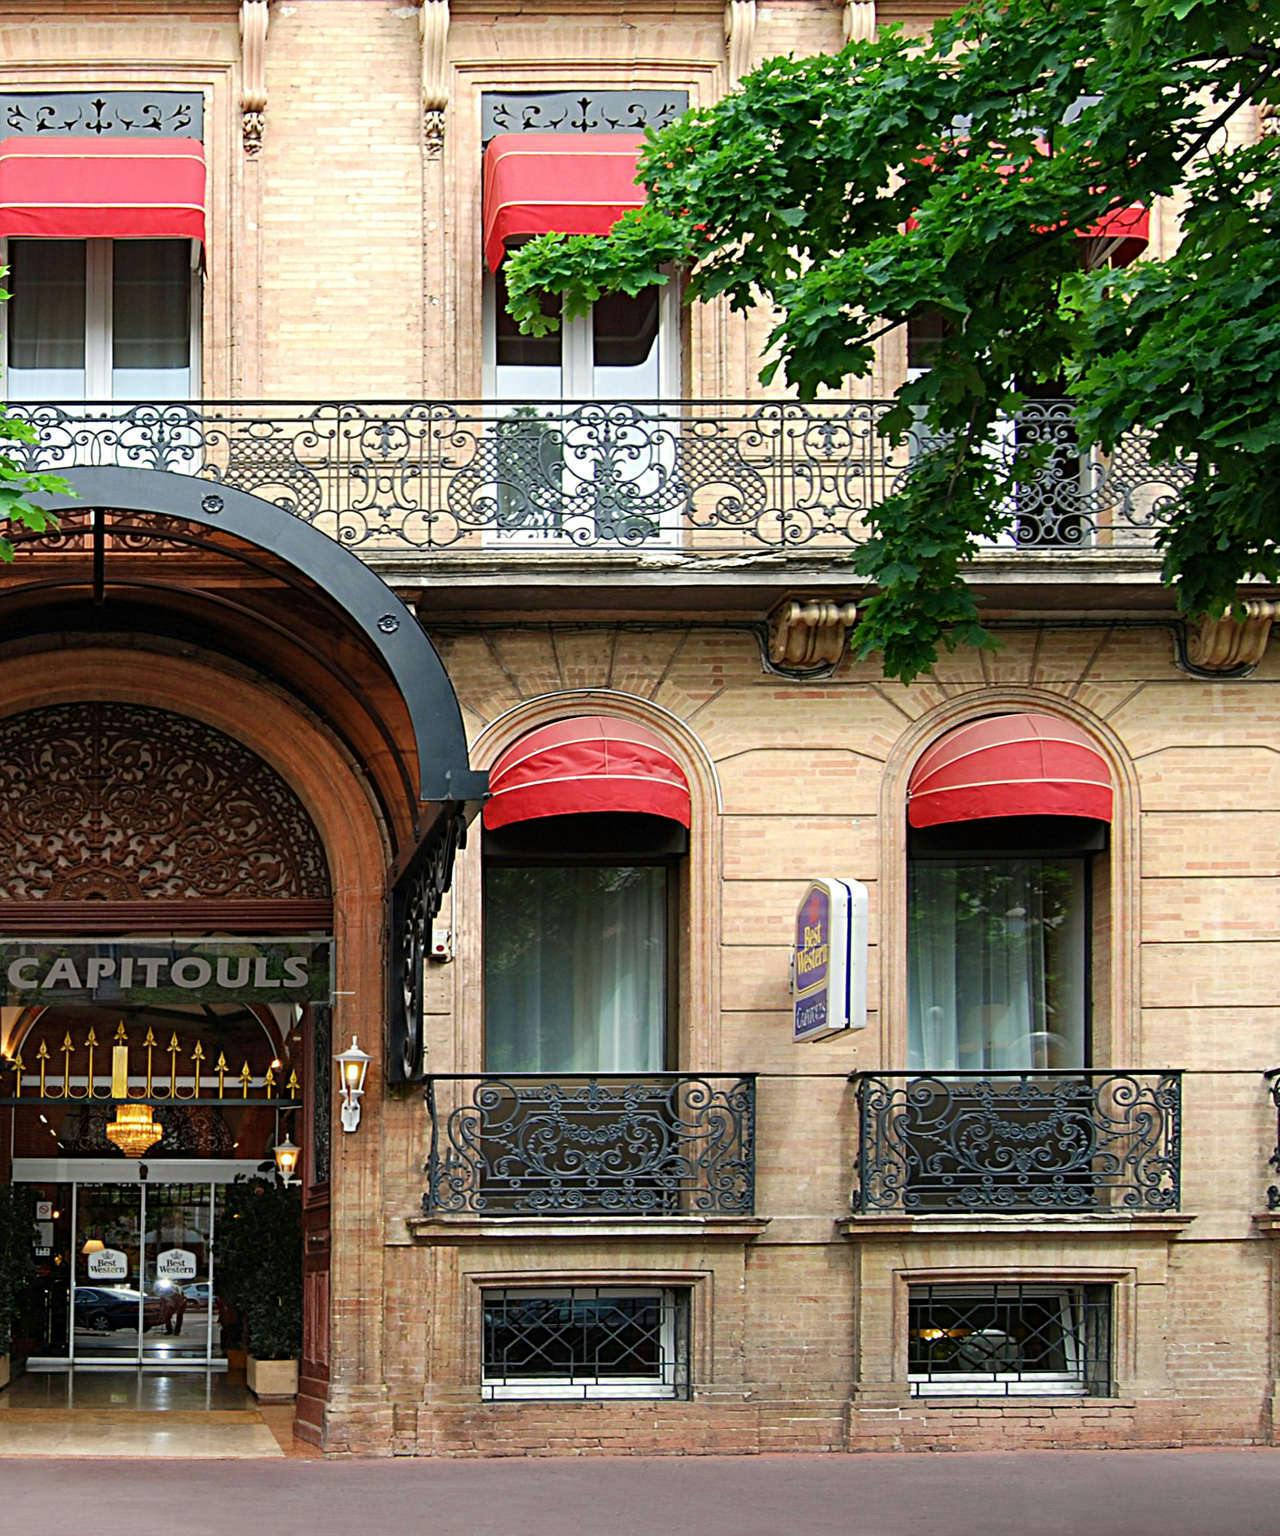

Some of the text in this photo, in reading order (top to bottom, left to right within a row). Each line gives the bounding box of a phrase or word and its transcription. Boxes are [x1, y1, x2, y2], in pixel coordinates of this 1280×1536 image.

[804, 921, 822, 948] Best
[797, 944, 829, 974] Western
[7, 956, 310, 990] CAPITOULS
[98, 1259, 117, 1267] Best
[167, 1259, 186, 1267] Best
[90, 1265, 125, 1274] Western
[160, 1265, 194, 1274] Western
